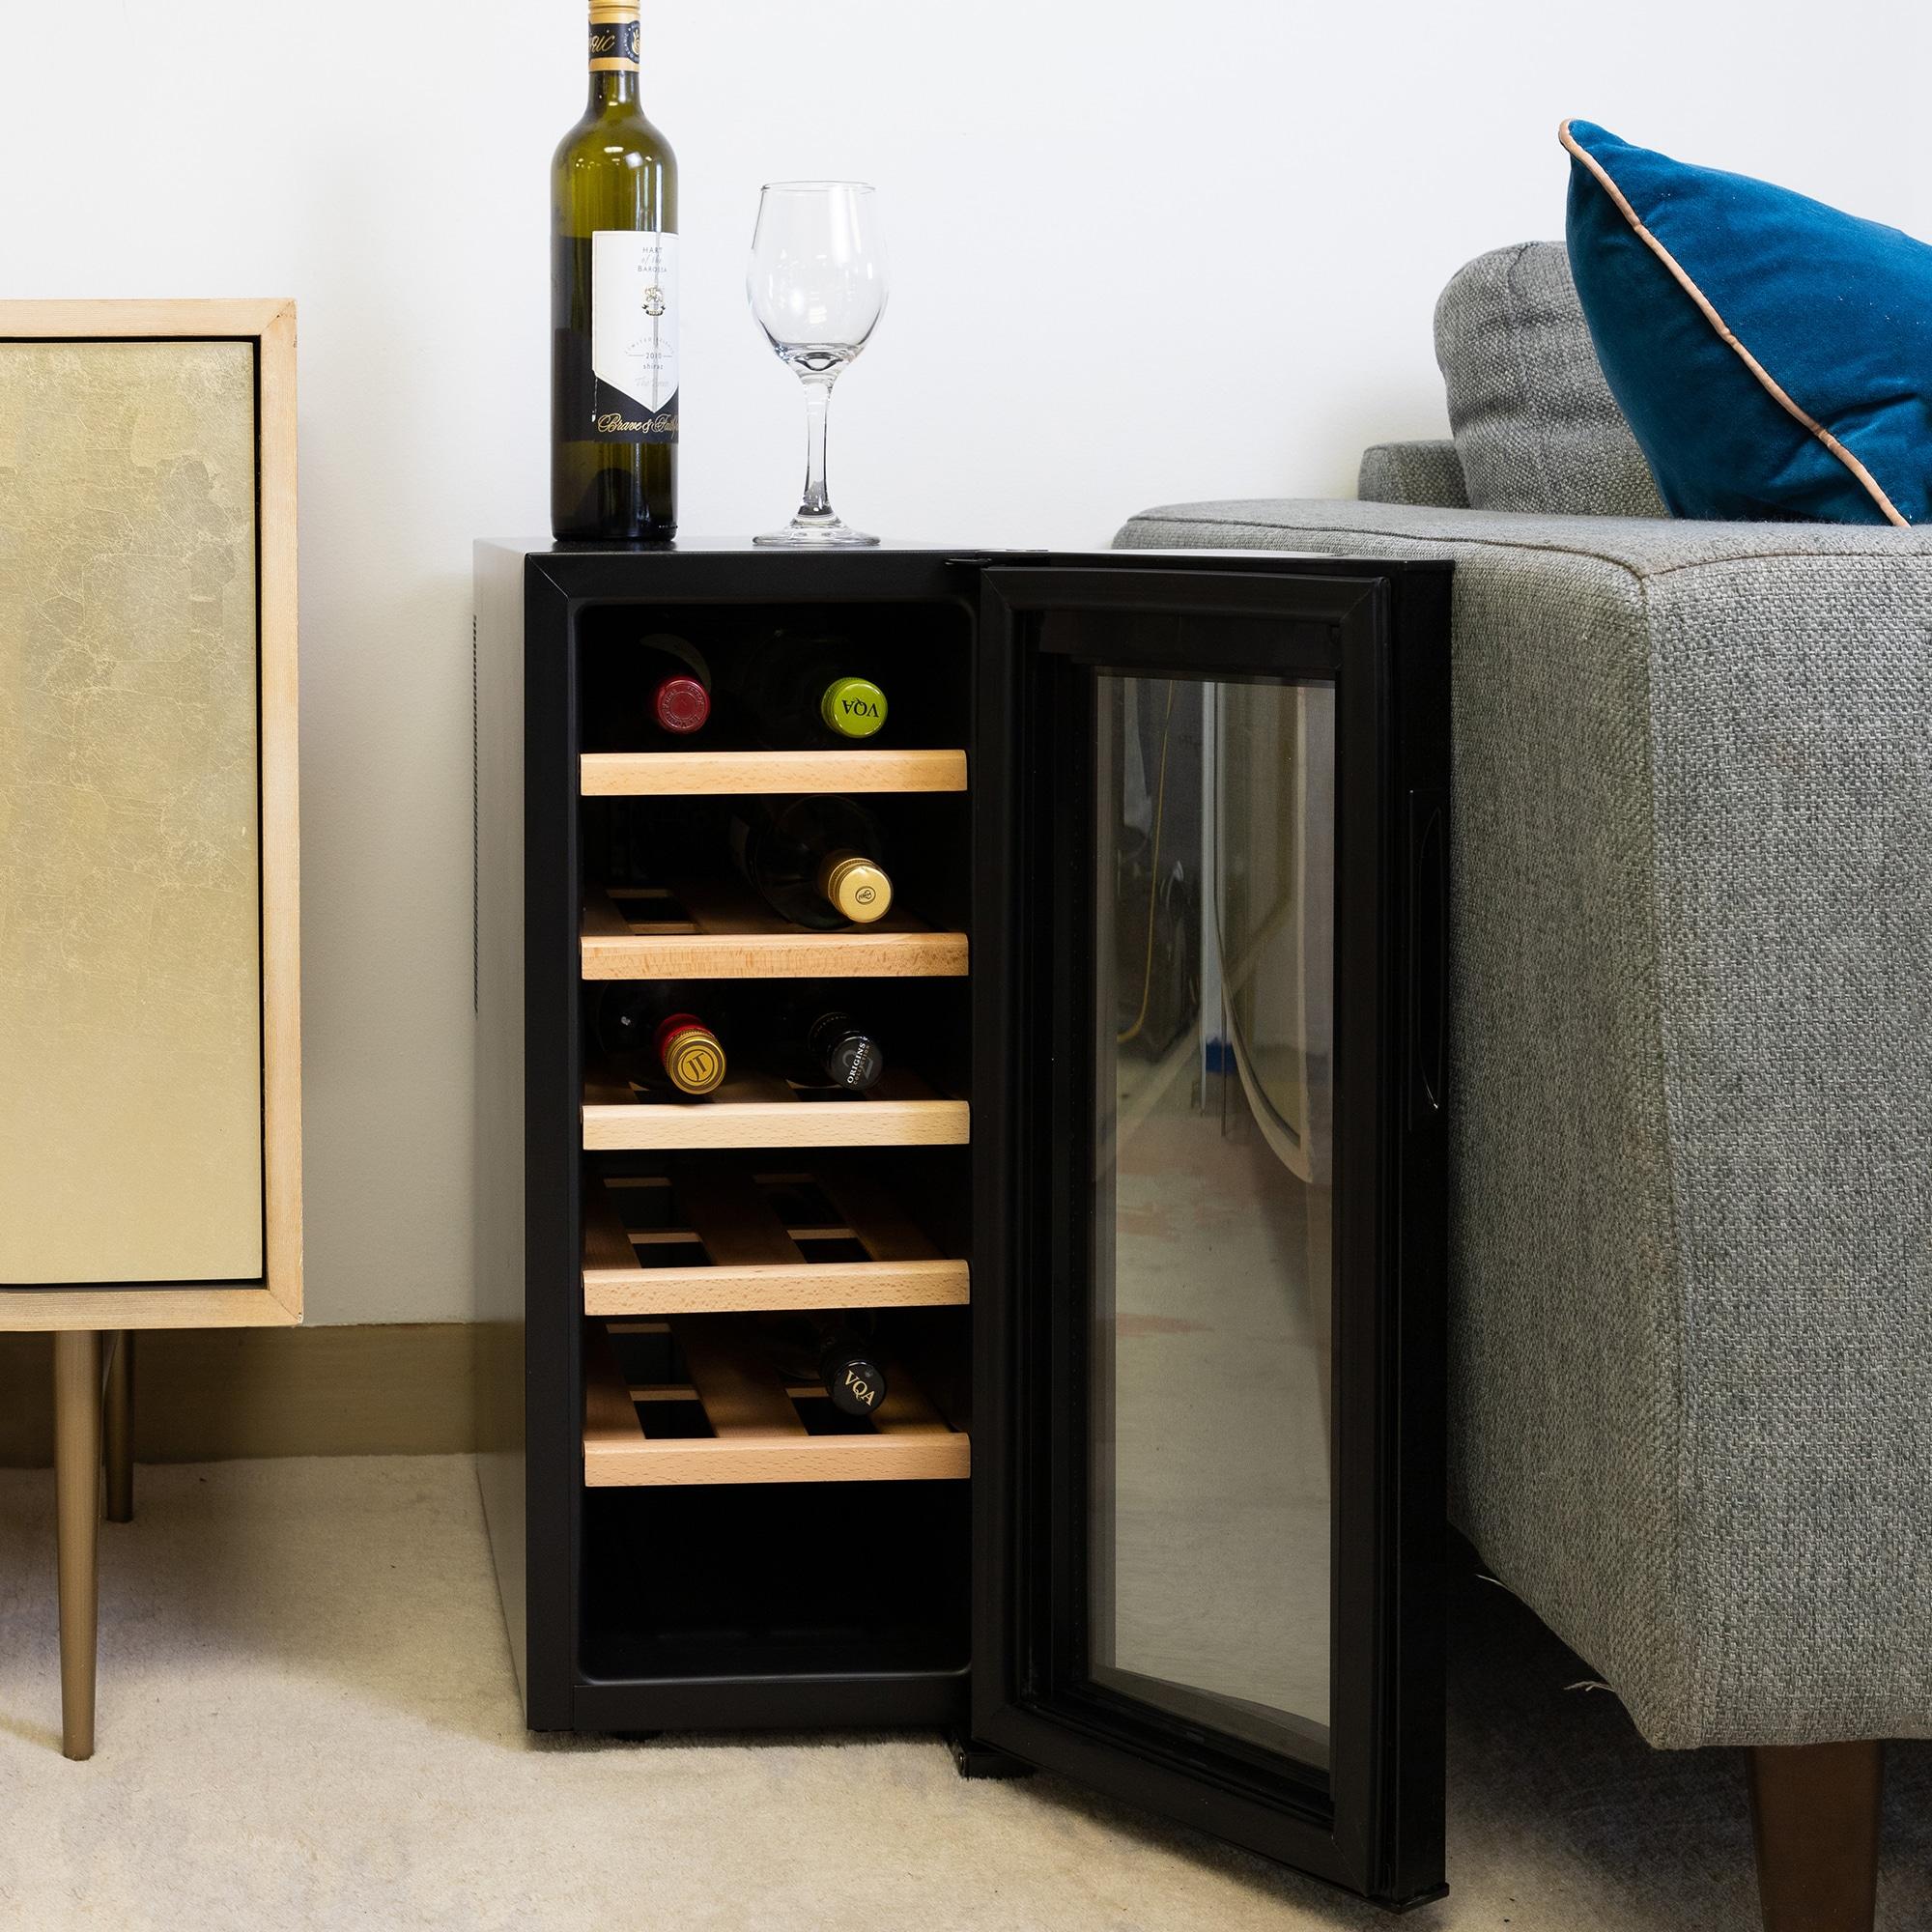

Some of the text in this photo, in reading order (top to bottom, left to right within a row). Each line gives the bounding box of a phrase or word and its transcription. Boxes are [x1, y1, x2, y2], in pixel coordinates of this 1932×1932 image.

[598, 412, 642, 433] Brave
[841, 696, 880, 718] VQA
[847, 1042, 867, 1084] ORIGINS
[853, 1045, 870, 1085] COLLECTION
[844, 1370, 875, 1406] VQA
